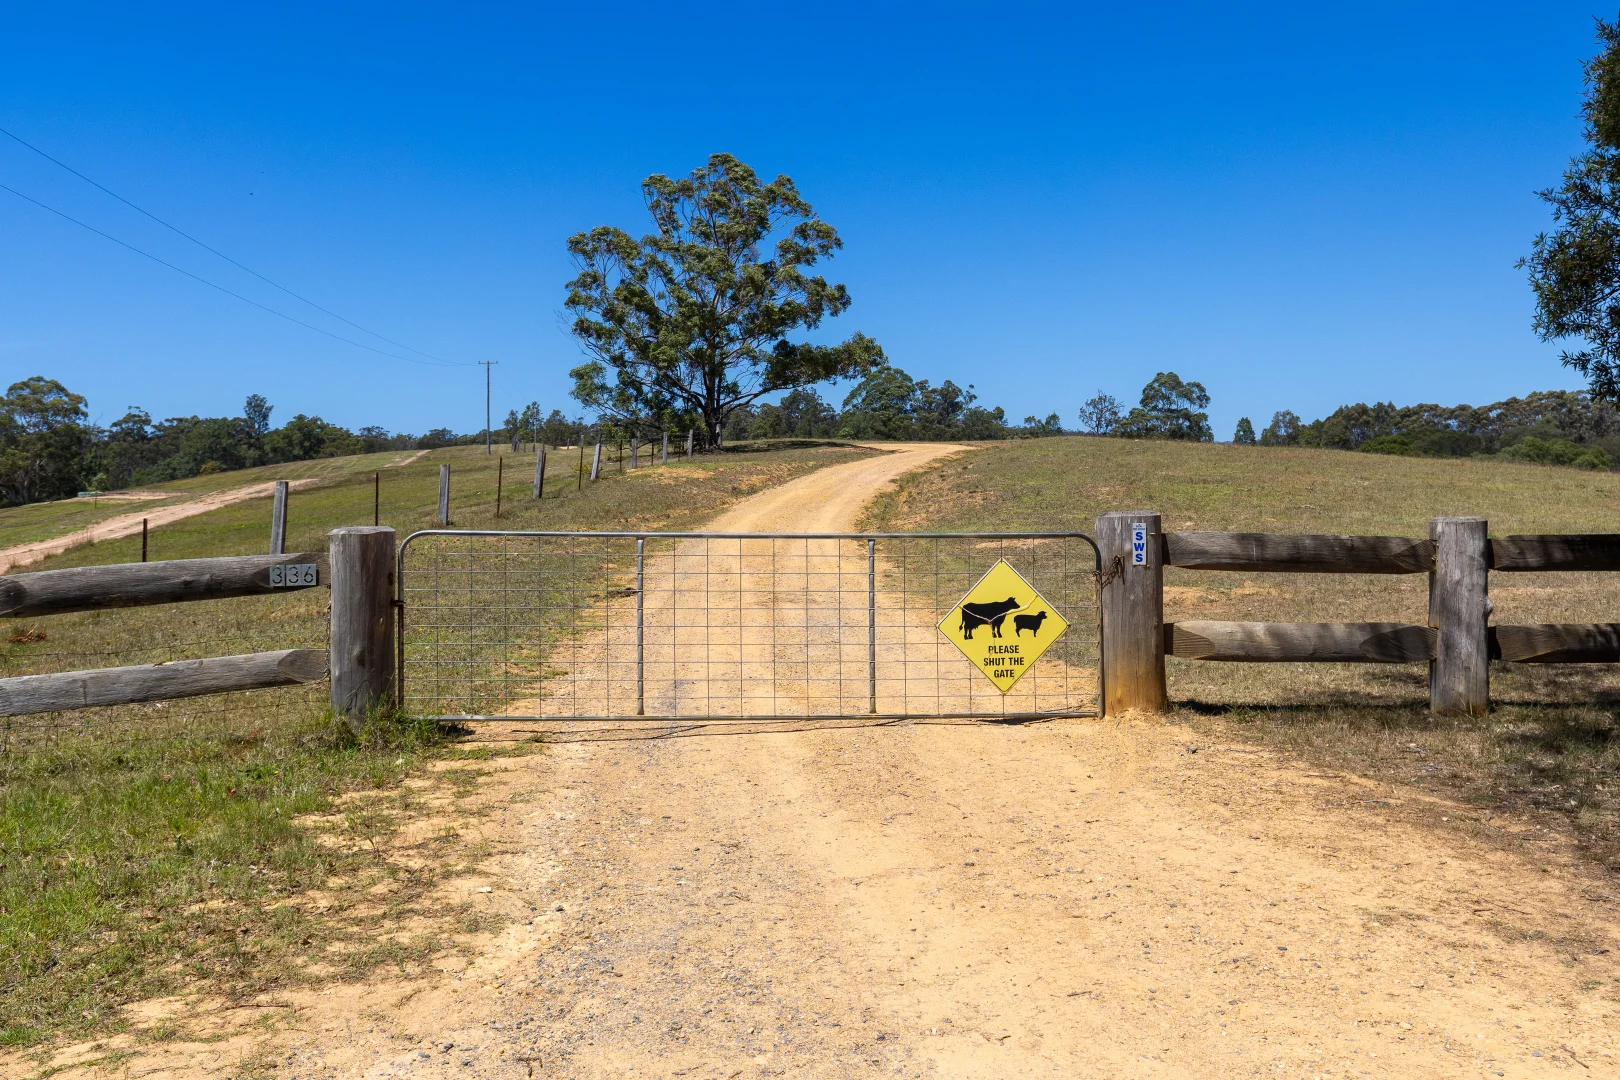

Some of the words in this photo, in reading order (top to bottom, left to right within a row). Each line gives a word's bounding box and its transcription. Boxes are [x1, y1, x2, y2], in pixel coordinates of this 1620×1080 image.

[272, 566, 314, 584] 336
[988, 645, 1020, 654] PLEASE
[984, 657, 1005, 666] SHUT
[1009, 657, 1024, 666] THE
[994, 669, 1014, 678] GATE
